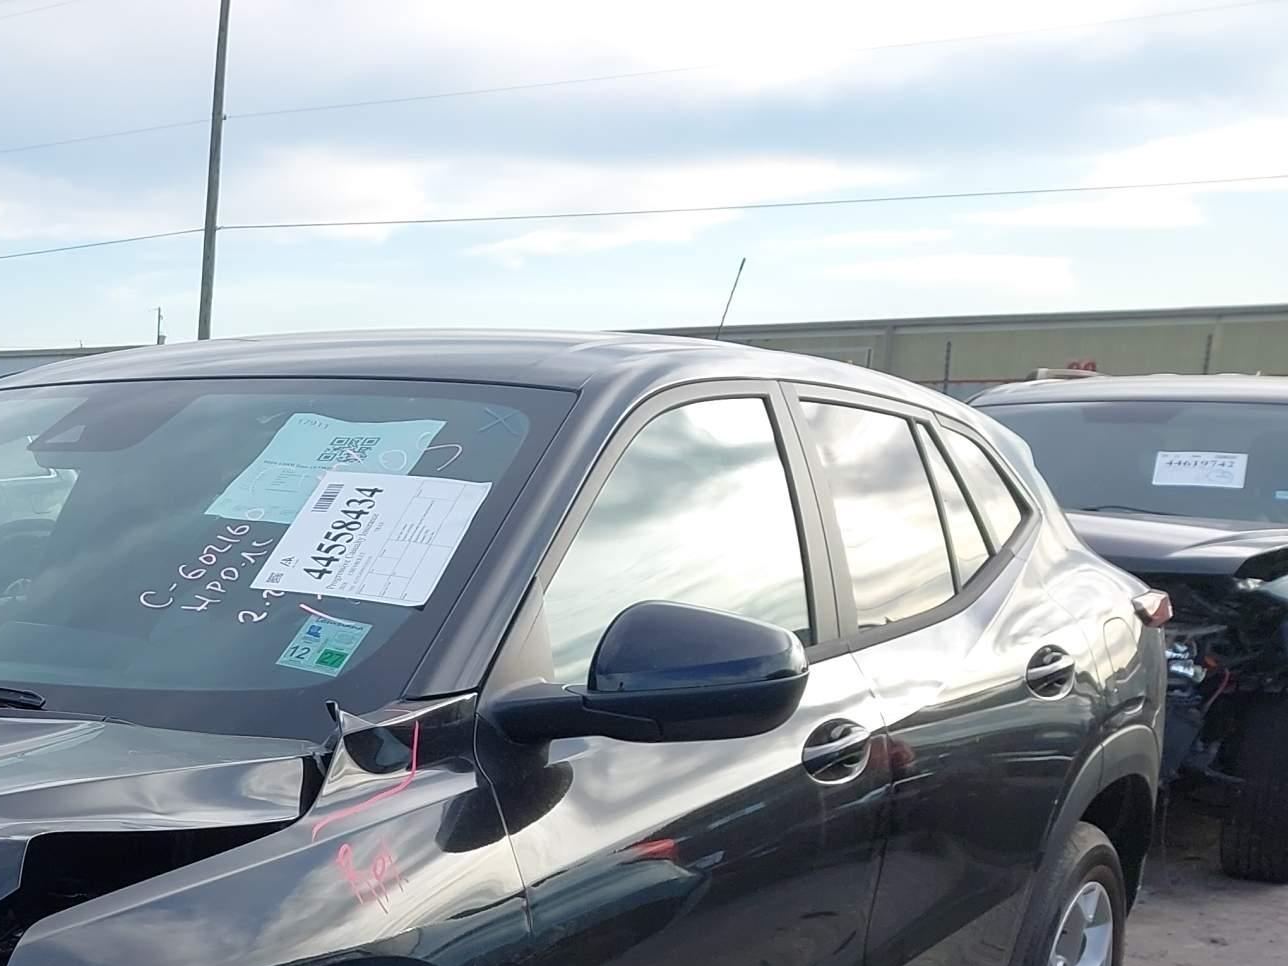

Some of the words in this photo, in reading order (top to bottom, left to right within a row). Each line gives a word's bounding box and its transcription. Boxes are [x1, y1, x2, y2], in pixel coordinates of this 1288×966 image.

[302, 487, 384, 580] 44558434
[289, 646, 311, 660] 12
[321, 652, 345, 666] 27
